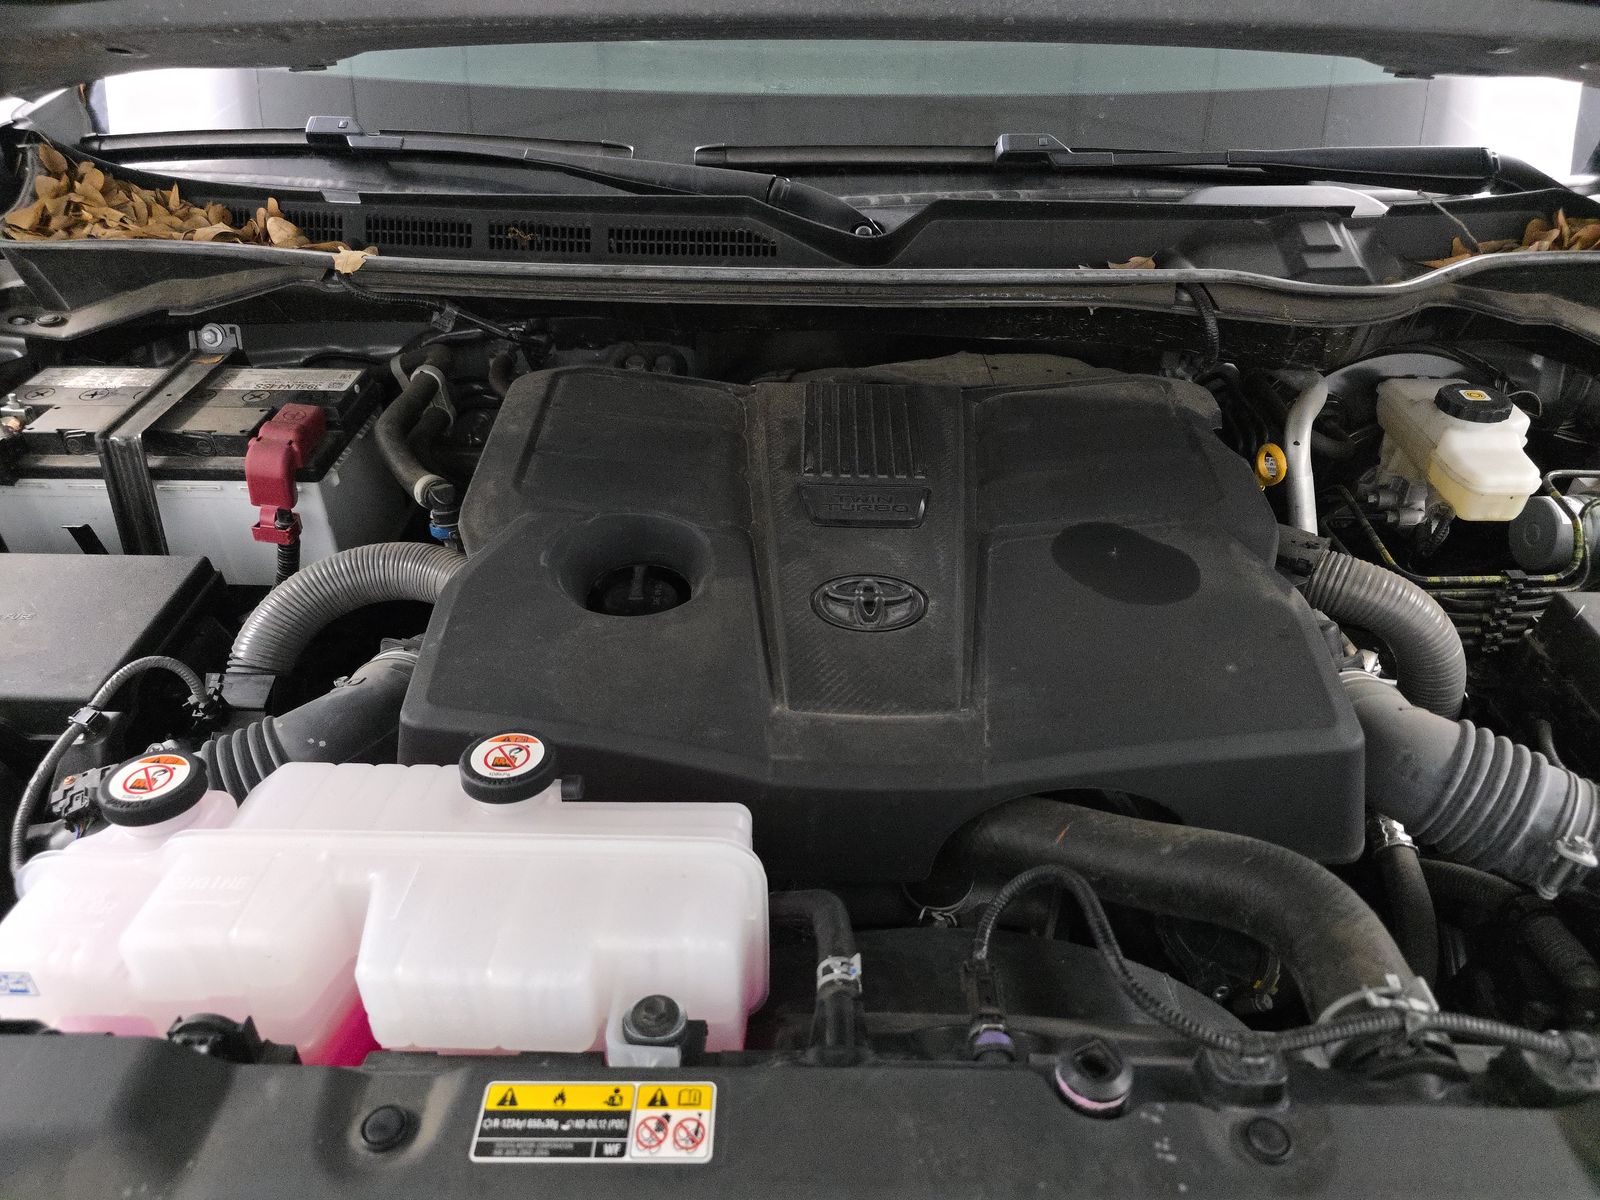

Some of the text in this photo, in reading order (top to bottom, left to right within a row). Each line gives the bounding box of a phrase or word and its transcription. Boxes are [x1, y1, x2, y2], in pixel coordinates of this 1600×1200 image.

[833, 494, 894, 504] TWIN
[821, 503, 909, 513] TURBO
[602, 1143, 621, 1156] WF
